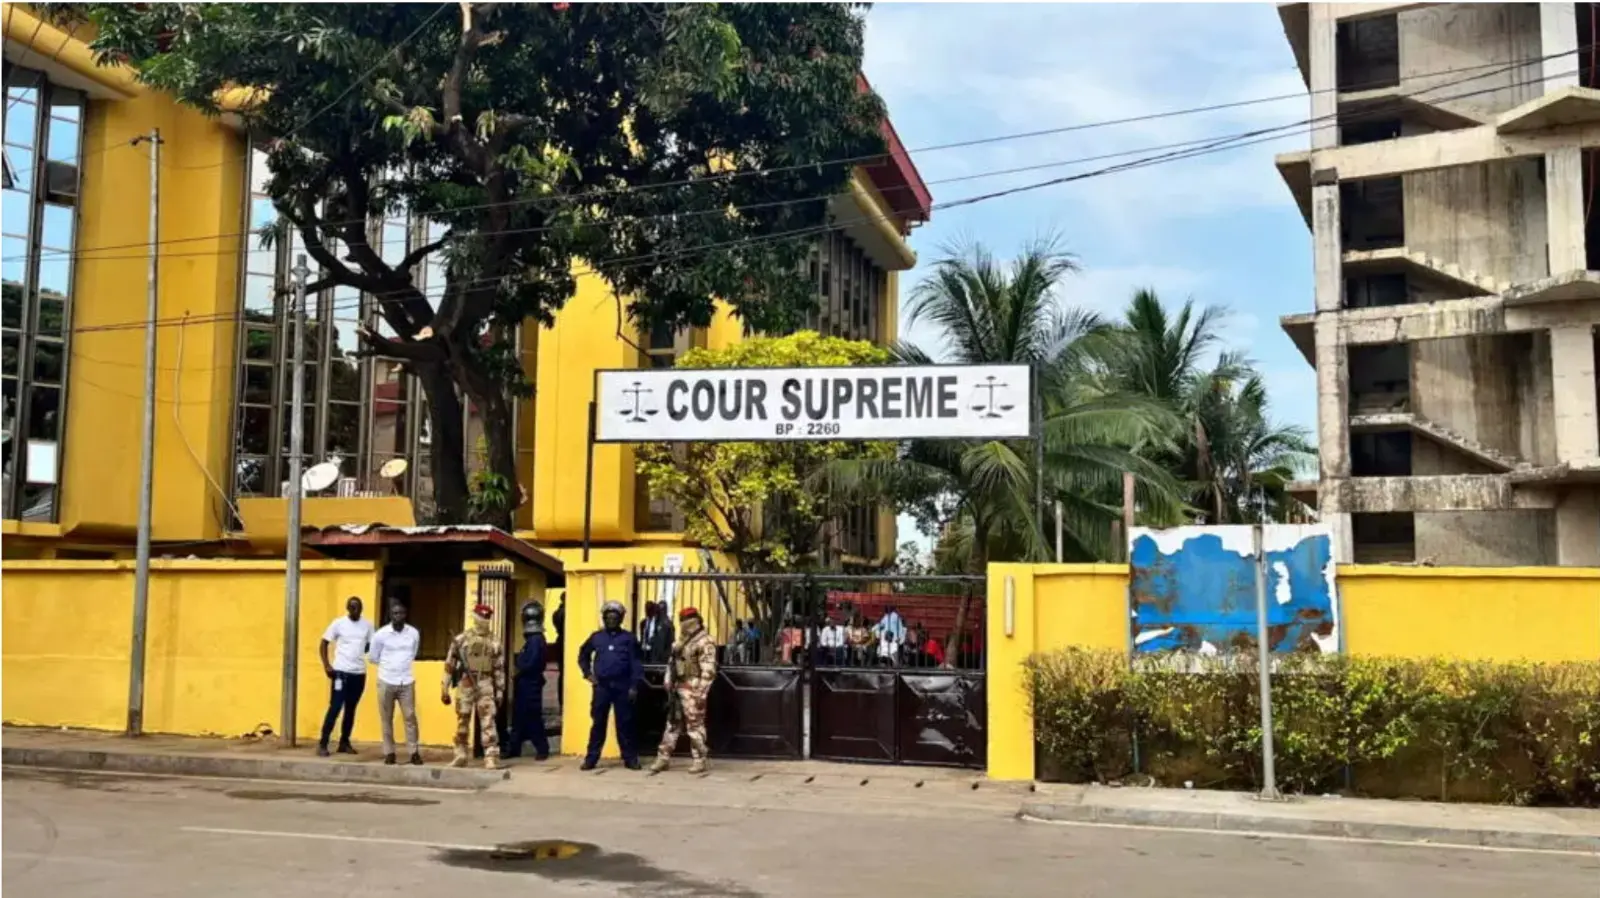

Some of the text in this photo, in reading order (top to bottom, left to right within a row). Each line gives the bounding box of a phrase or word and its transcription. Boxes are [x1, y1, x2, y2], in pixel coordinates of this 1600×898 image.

[666, 376, 958, 421] COUR SUPREME
[775, 423, 794, 435] BP
[807, 423, 840, 435] 2260
